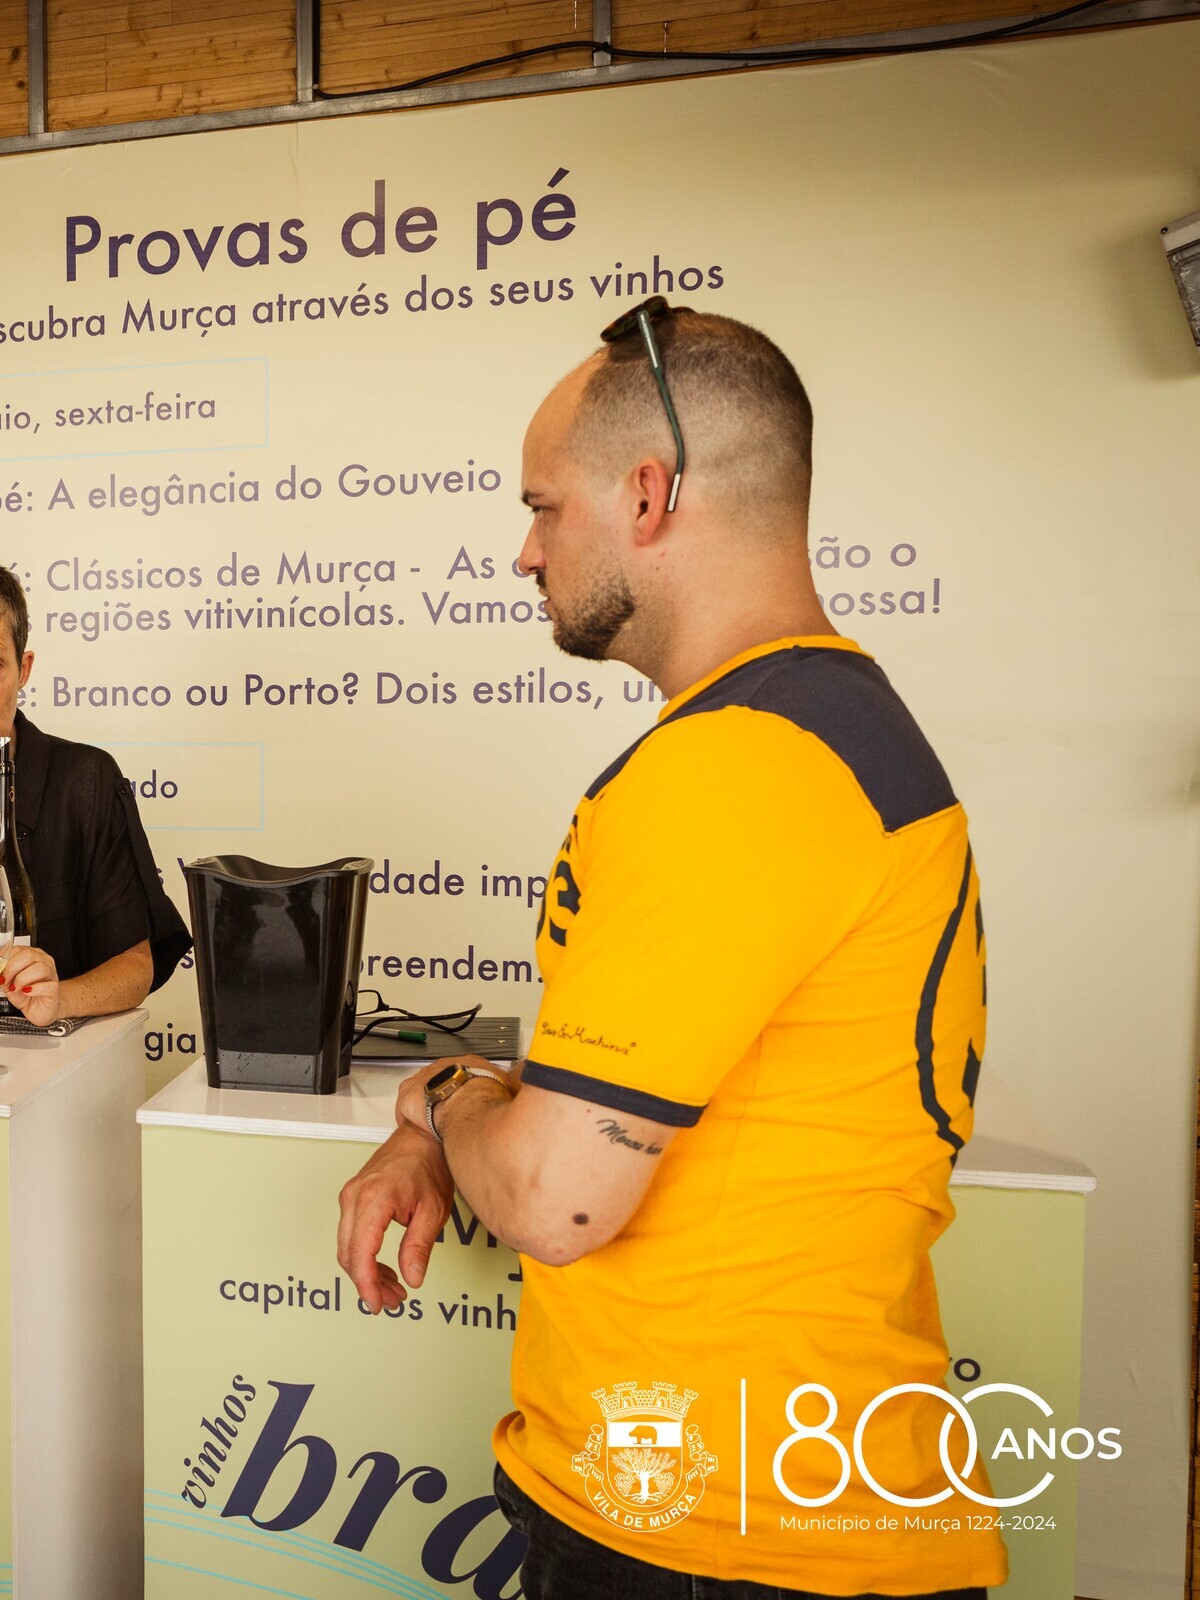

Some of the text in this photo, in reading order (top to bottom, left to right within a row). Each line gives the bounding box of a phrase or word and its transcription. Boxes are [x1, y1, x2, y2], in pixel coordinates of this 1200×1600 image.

[65, 166, 577, 283] Provas de pé
[121, 298, 236, 338] Murça
[252, 282, 389, 324] através
[404, 274, 473, 313] dos
[489, 276, 574, 307] seus
[589, 255, 724, 297] vinhos
[54, 391, 216, 428] sexta-feira
[47, 477, 76, 511] A
[88, 470, 259, 517] elegância
[275, 464, 322, 501] do
[338, 459, 502, 498] Gouveio
[46, 556, 203, 593] Clássicos
[216, 551, 261, 587] de
[276, 550, 396, 585] Murça
[446, 544, 496, 580] As
[809, 536, 871, 570] ão
[890, 543, 917, 567] o
[46, 594, 172, 637] regiões
[183, 590, 405, 630] vitivinícolas.
[421, 590, 550, 624] Vamos
[53, 676, 172, 707] Branco
[185, 685, 228, 707] ou
[245, 671, 359, 706] Porto?
[376, 671, 457, 705] Dois
[472, 666, 604, 710] estilos,
[481, 863, 547, 909] imp
[359, 944, 544, 984] reendem.
[219, 1275, 342, 1314] capital
[437, 1293, 517, 1332] vinh
[181, 1373, 257, 1509] vinhos
